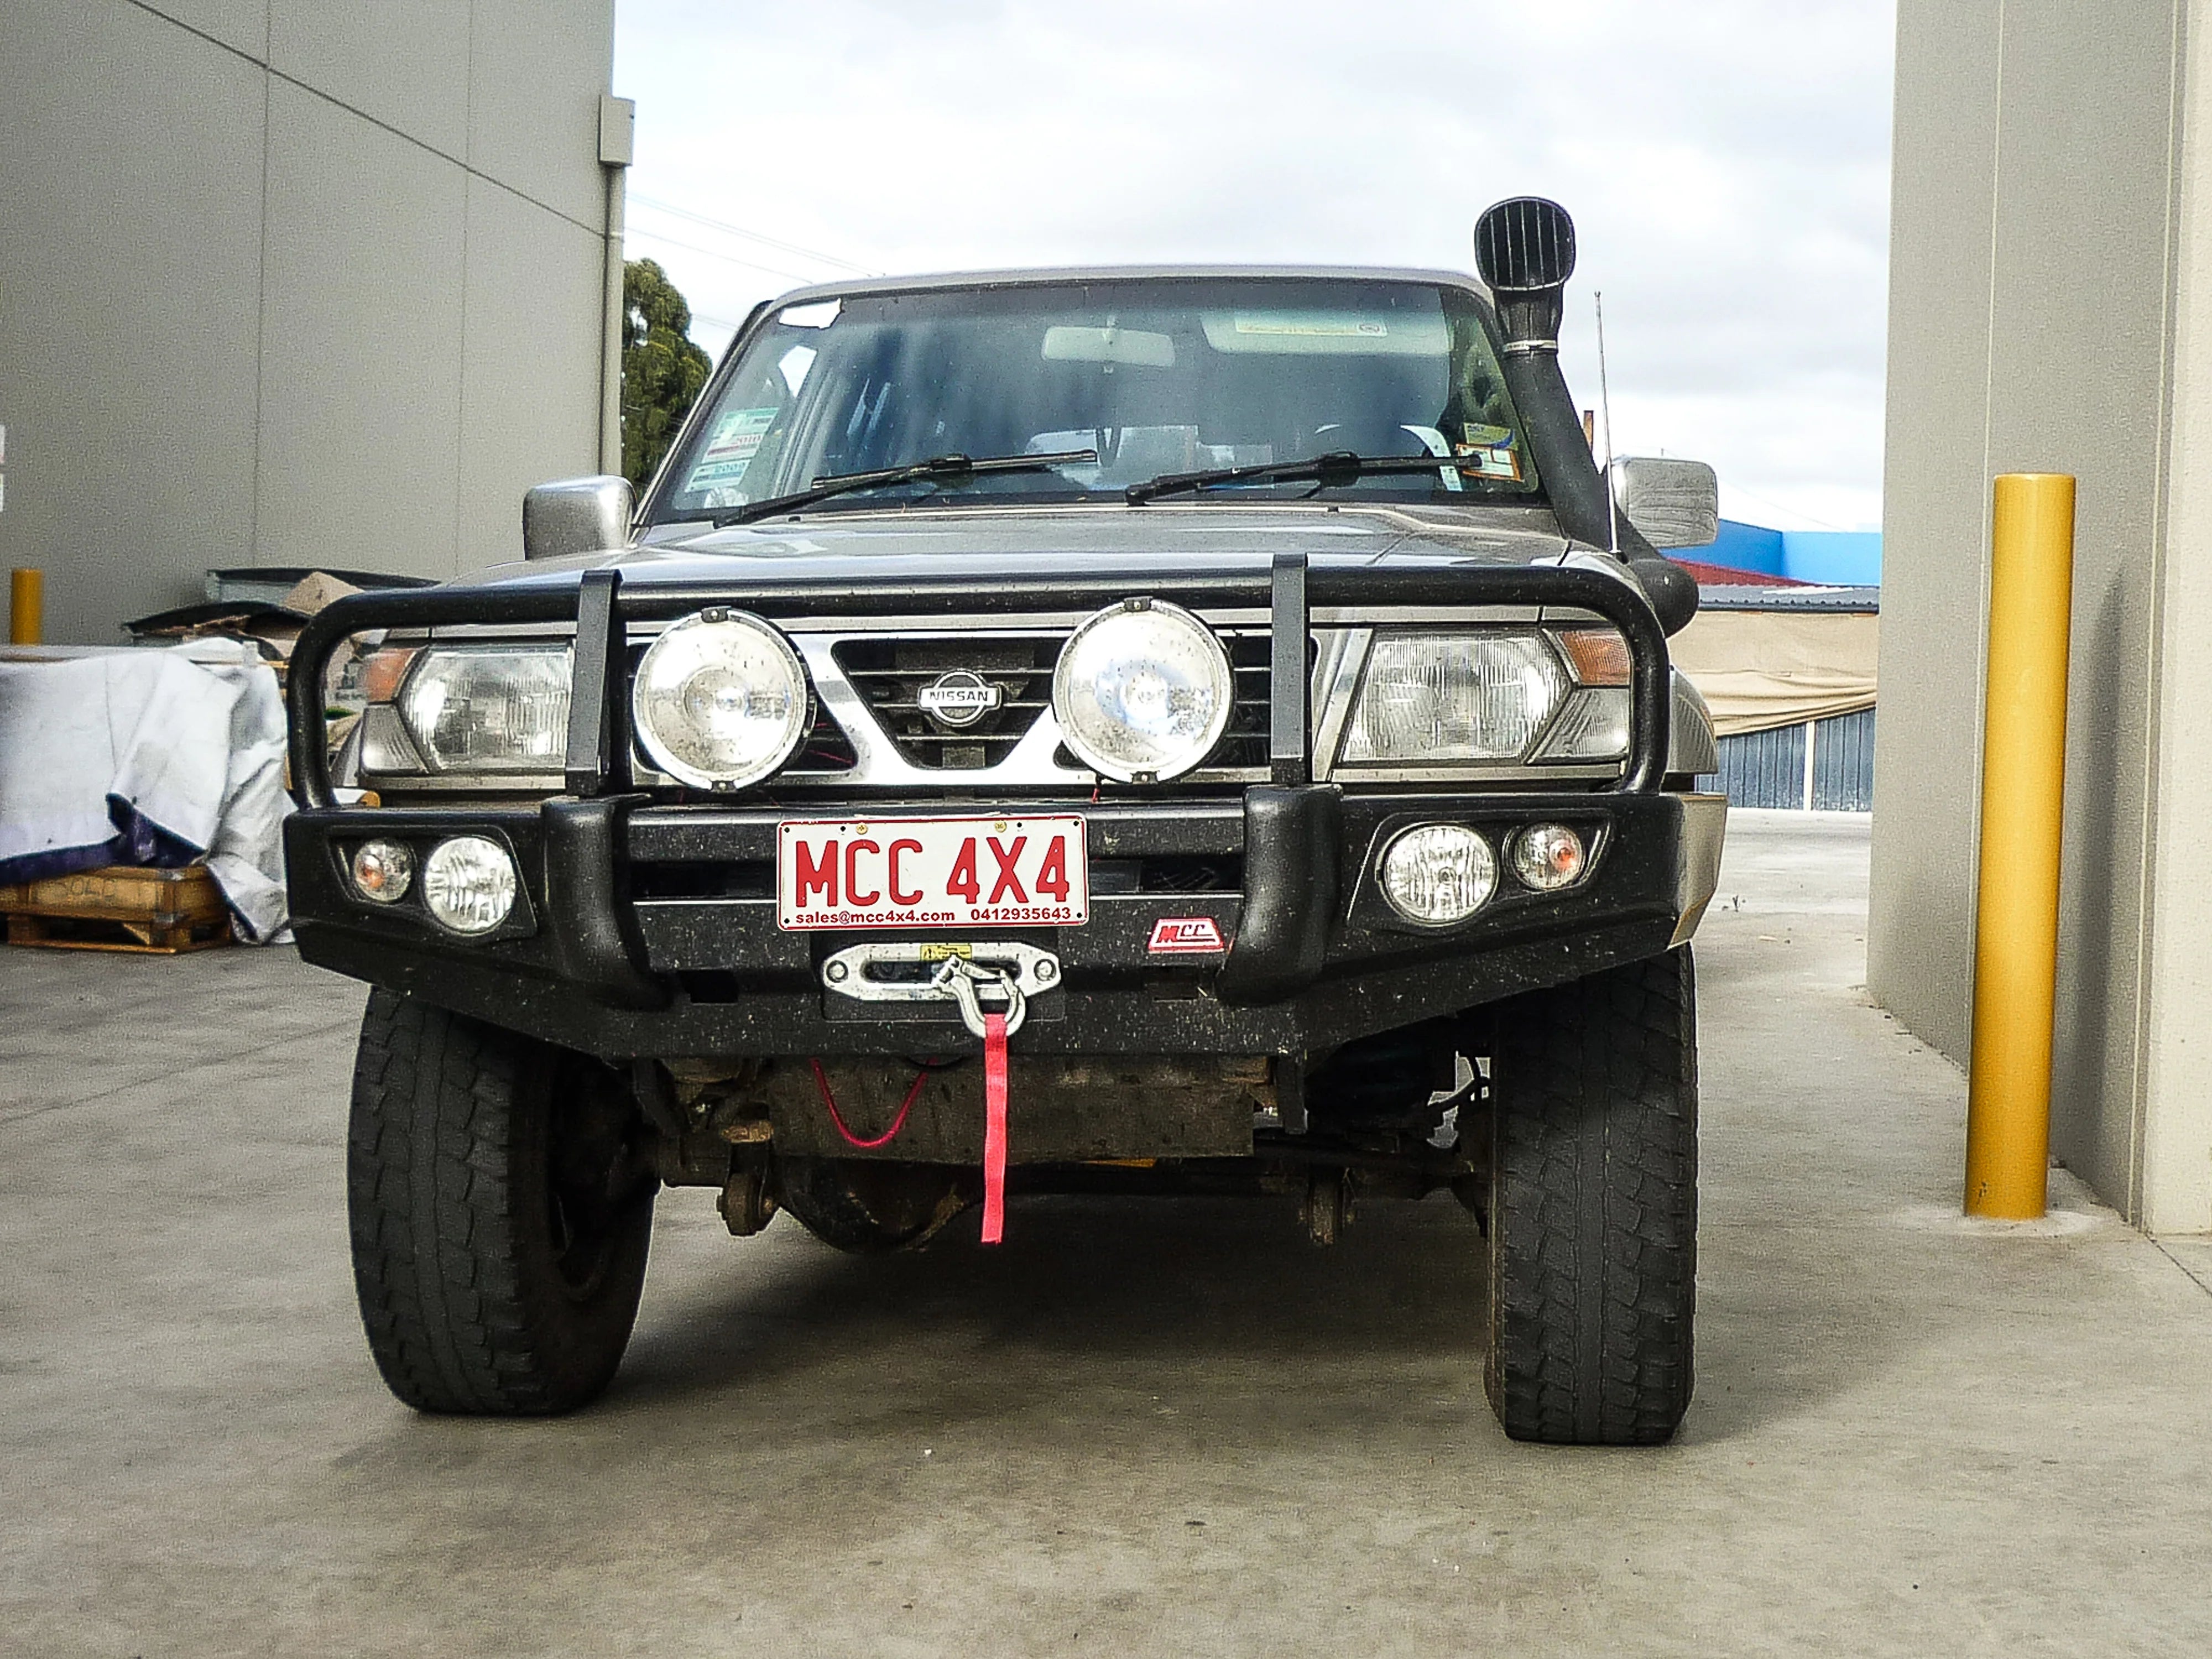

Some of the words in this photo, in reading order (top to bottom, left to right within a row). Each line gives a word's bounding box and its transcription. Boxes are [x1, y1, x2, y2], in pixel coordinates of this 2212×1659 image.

[930, 691, 988, 702] NISSAN
[795, 838, 924, 908] MCC
[946, 835, 1070, 905] 4X4
[796, 910, 955, 924] sales@mcc4x4.com
[971, 907, 1071, 921] 0412935643
[1156, 924, 1215, 943] MCC
